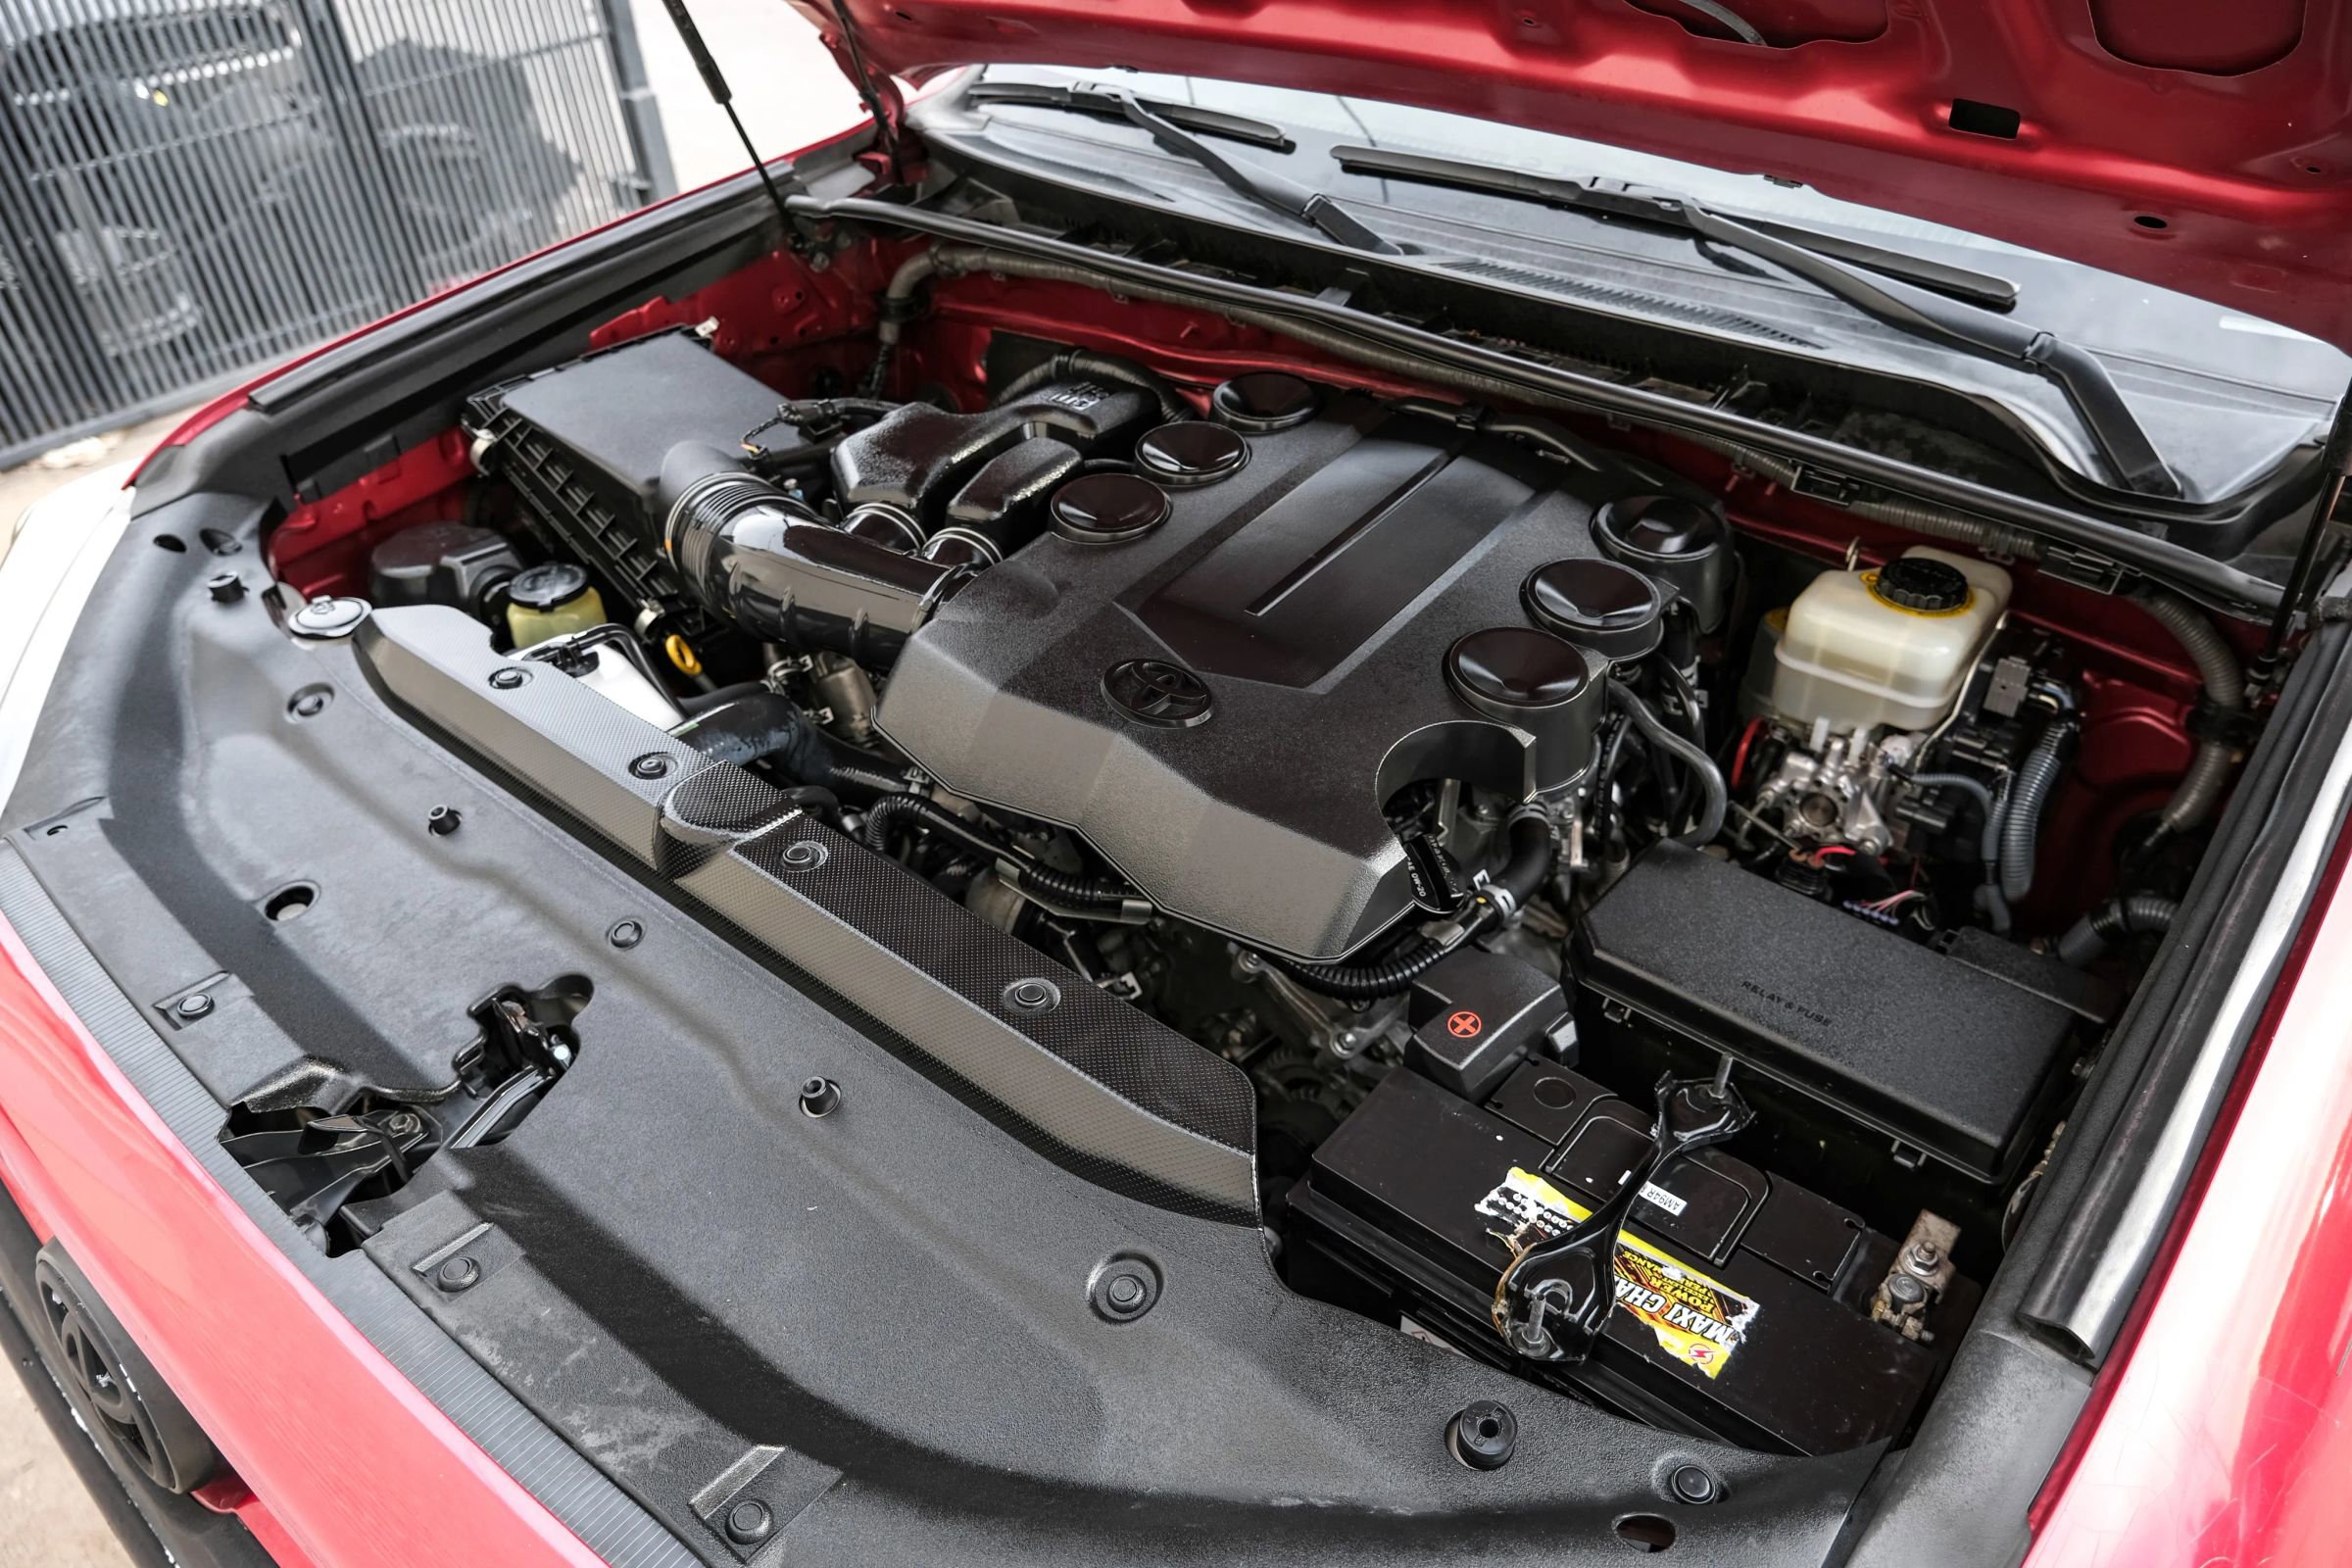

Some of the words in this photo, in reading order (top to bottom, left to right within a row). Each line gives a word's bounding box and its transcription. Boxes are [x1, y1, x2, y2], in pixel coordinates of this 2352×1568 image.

[1411, 872, 1427, 897] 0W-20
[1740, 981, 1783, 1004] RELAY
[1784, 1001, 1795, 1010] &
[1795, 1006, 1833, 1027] FUSE
[1646, 1188, 1682, 1210] AM94R
[1615, 1275, 1667, 1314] CHA
[1649, 1276, 1715, 1314] POWER
[1662, 1277, 1709, 1301] EXCELLENT
[1662, 1301, 1736, 1345] MAXI
